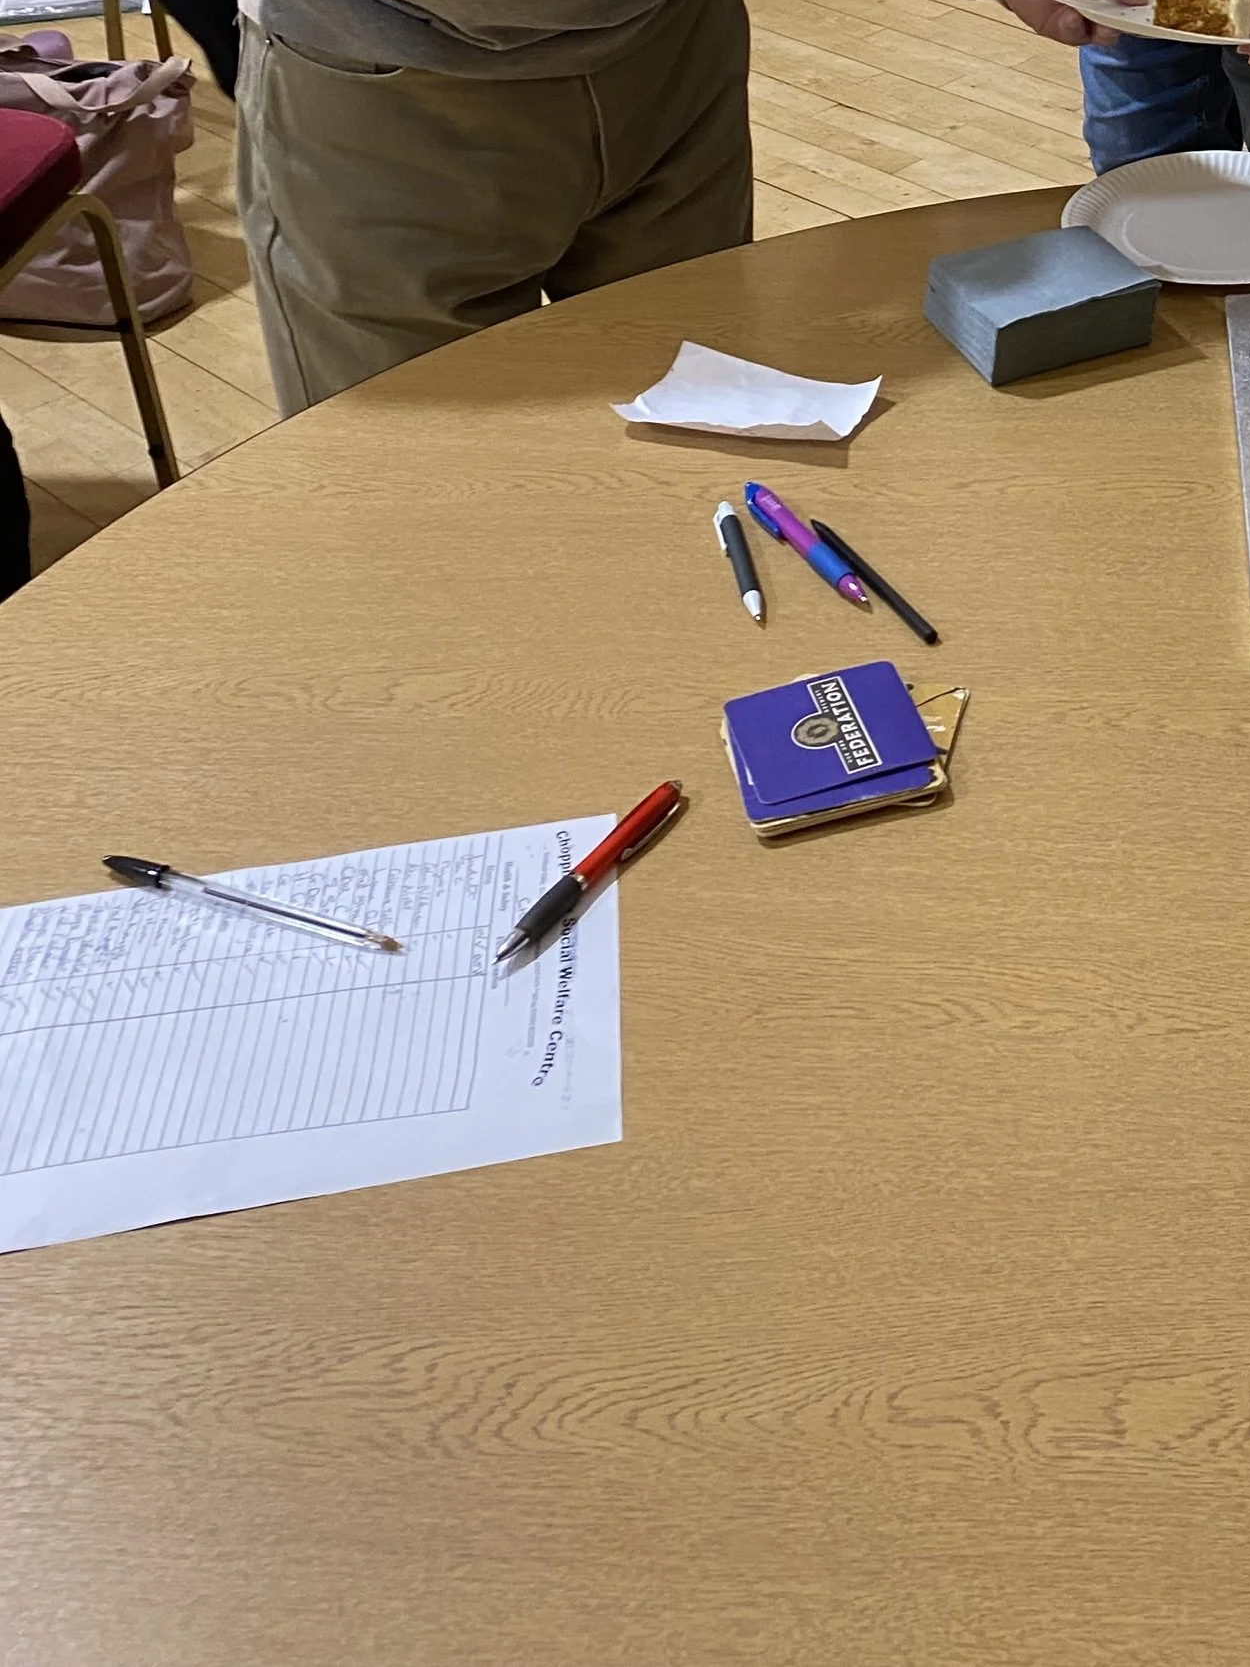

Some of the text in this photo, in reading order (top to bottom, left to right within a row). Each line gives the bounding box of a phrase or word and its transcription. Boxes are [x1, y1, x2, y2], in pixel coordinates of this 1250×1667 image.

[821, 681, 875, 766] FEDERATION
[559, 918, 577, 967] Social
[551, 967, 574, 1025] Welfare
[530, 1030, 563, 1087] Centre
